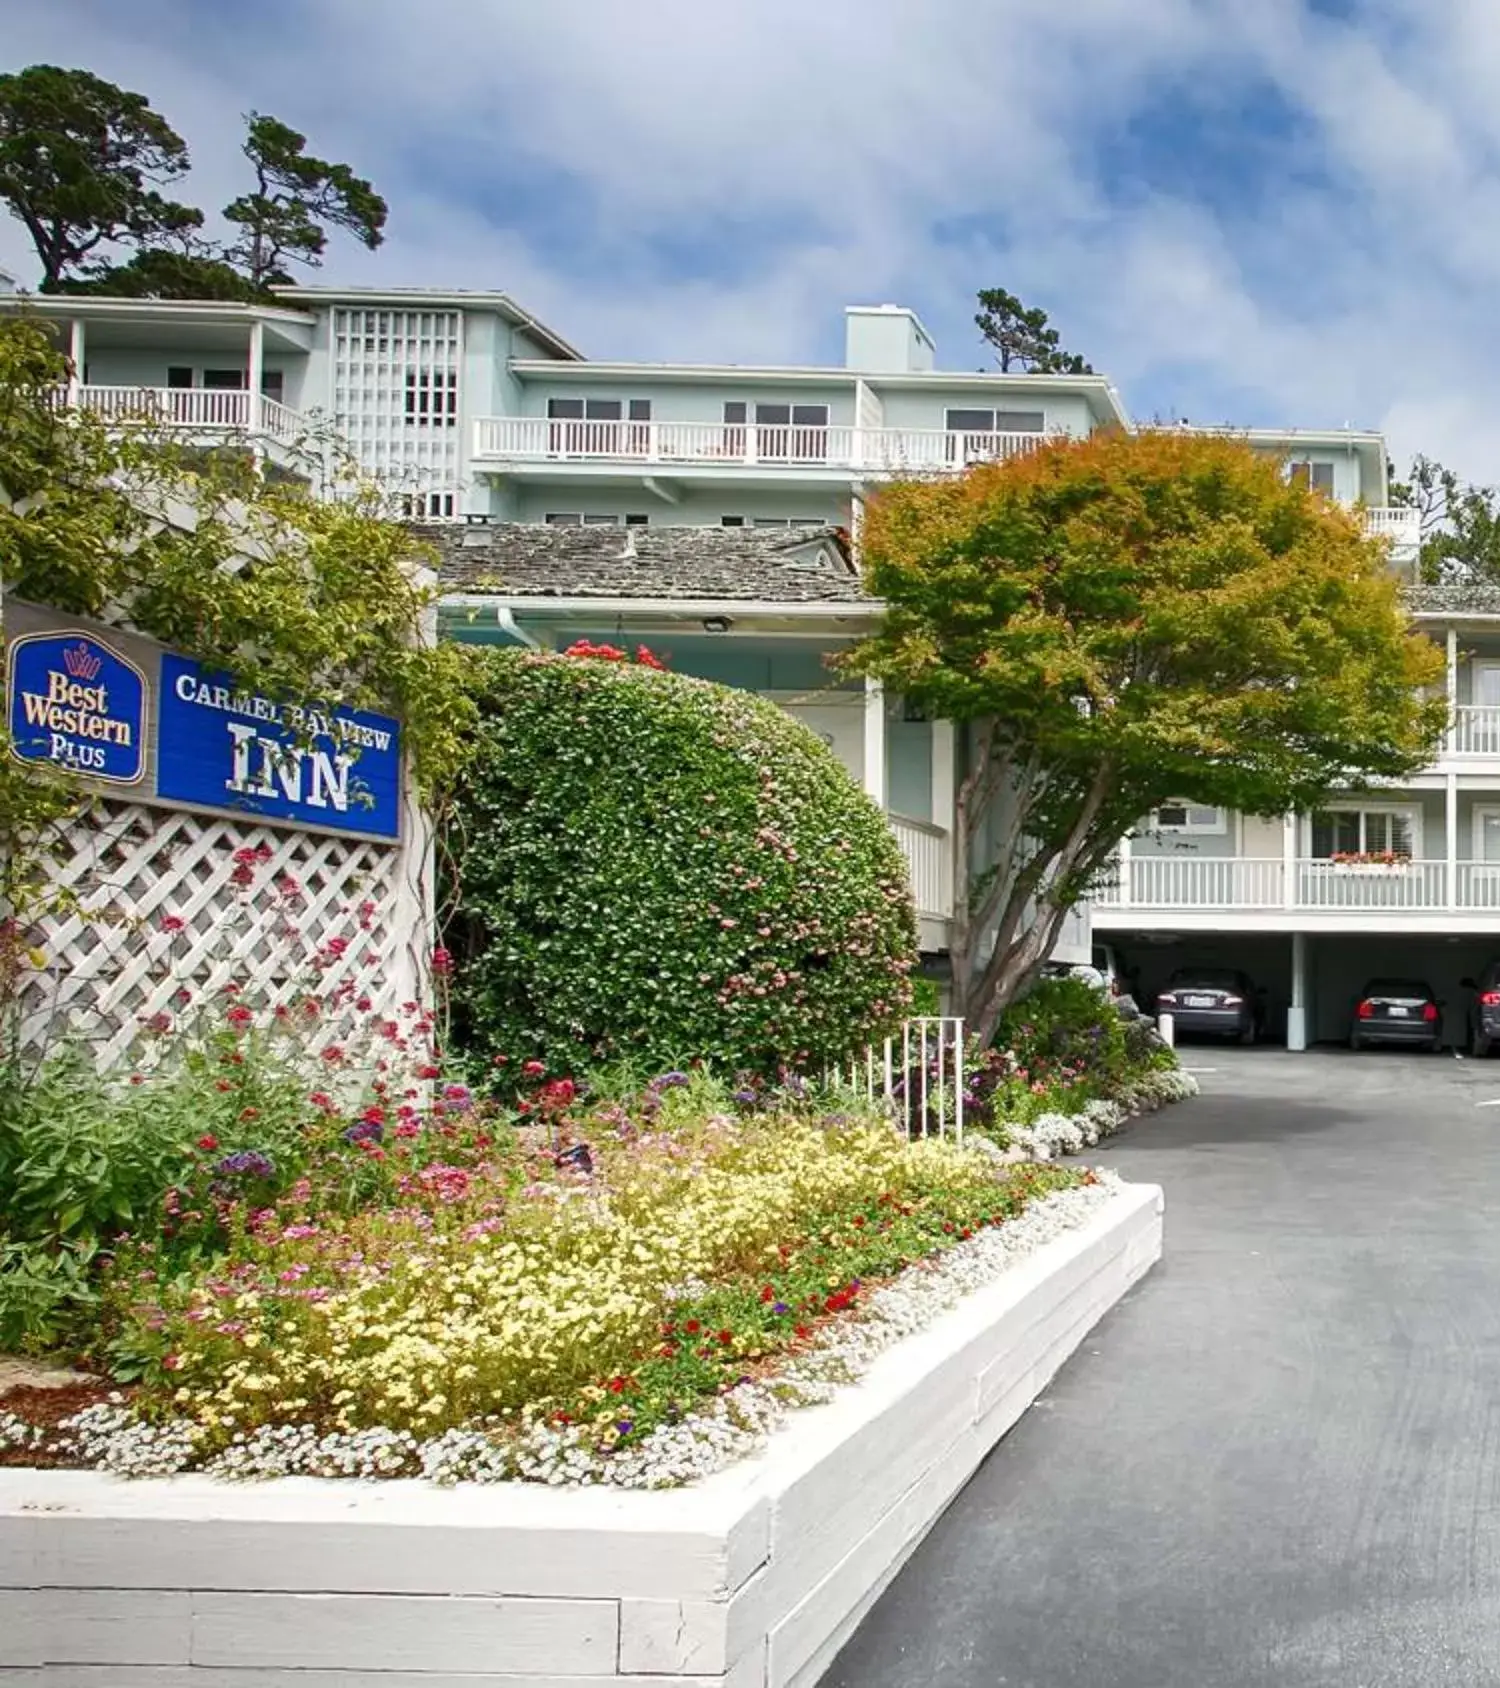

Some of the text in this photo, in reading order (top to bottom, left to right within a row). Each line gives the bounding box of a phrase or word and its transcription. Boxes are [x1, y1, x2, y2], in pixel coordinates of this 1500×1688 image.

[22, 692, 132, 746] Western
[48, 670, 109, 714] Best
[176, 674, 284, 724] CARMEL
[336, 717, 392, 751] VIEW
[225, 722, 352, 811] INN
